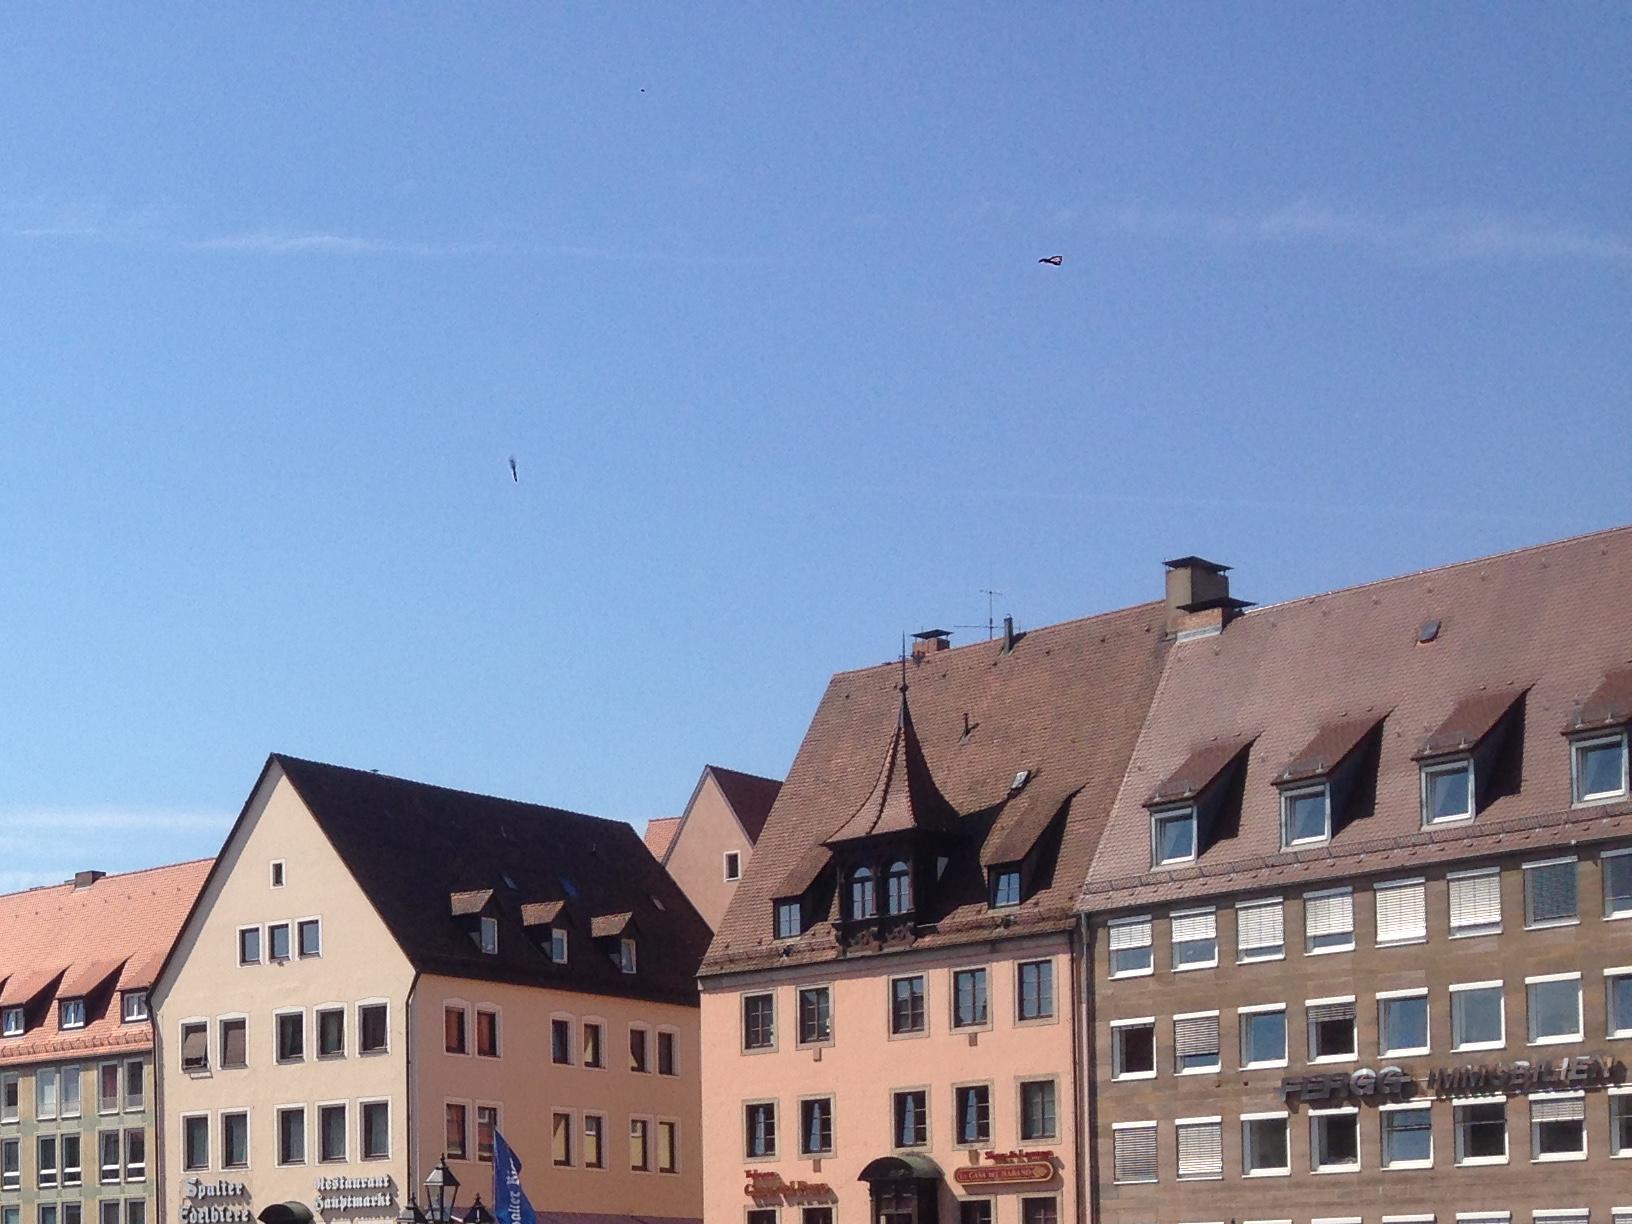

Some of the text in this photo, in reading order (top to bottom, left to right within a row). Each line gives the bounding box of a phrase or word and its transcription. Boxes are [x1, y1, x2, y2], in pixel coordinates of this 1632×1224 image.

[314, 1174, 390, 1191] Restaurant
[315, 1192, 391, 1213] Hauptmarkt
[180, 1204, 249, 1224] Edelbiere
